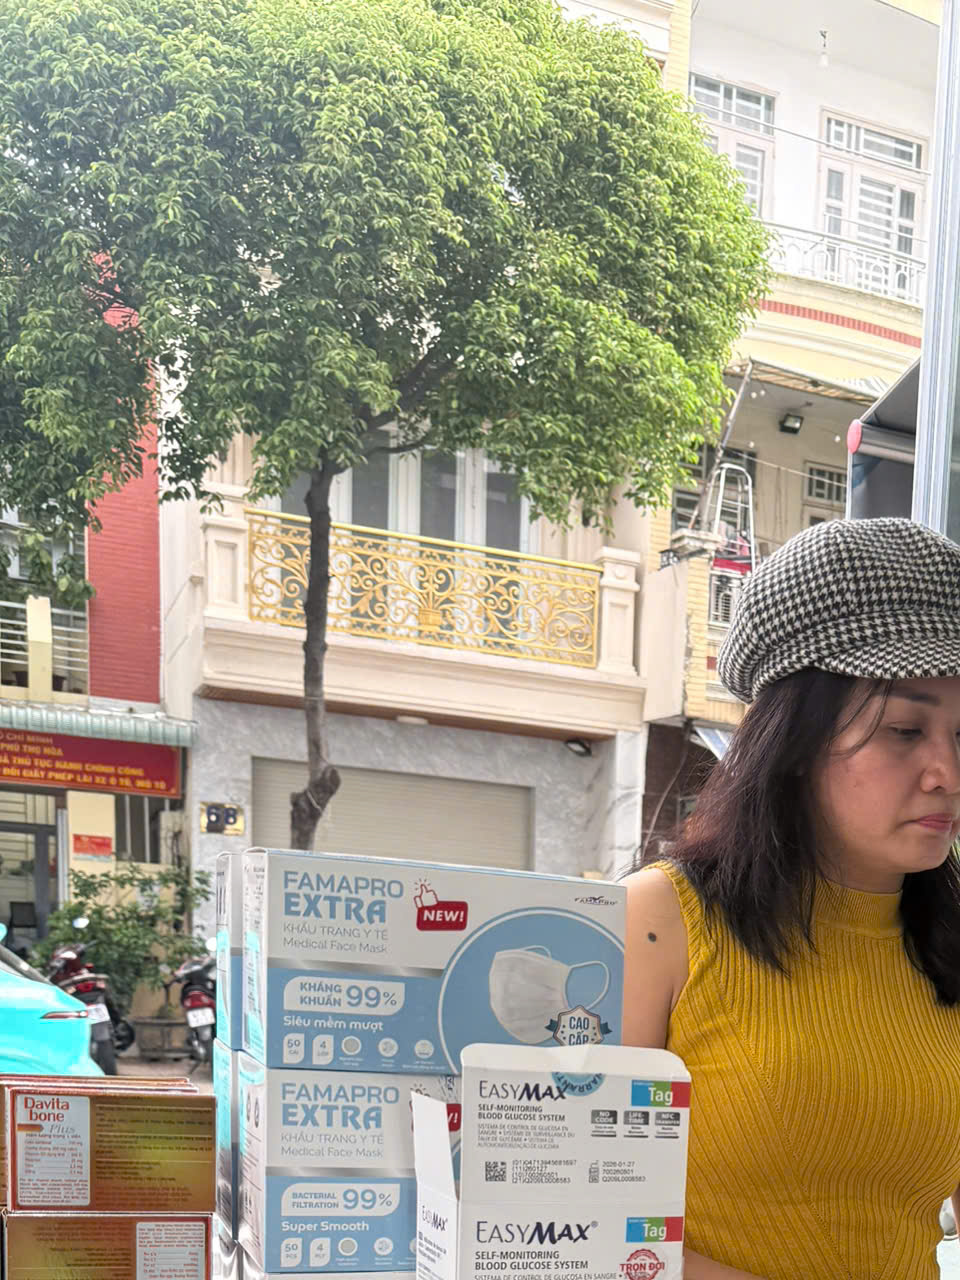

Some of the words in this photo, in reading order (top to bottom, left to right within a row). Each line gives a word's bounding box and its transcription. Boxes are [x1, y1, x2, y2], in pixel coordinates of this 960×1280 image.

[283, 870, 404, 898] FAMAPRO
[284, 892, 386, 924] EXTRA
[423, 910, 465, 922] NEW!
[320, 926, 360, 938] TRANG
[364, 929, 372, 938] Y
[283, 937, 327, 950] Medical
[330, 940, 356, 951] Face
[360, 943, 387, 954] Mask
[300, 981, 341, 993] KHÁNG
[284, 1016, 311, 1026] Siêu
[569, 1017, 589, 1030] CAO
[288, 1038, 300, 1048] 50
[281, 1083, 400, 1104] FAMAPRO
[479, 1080, 567, 1101] EASYMAX
[648, 1087, 673, 1105] Tag
[24, 1097, 70, 1110] Davita
[478, 1104, 542, 1113] SELF-MONITORING
[29, 1109, 64, 1121] bone
[283, 1104, 382, 1130] EXTRA
[478, 1112, 502, 1120] BLOOD
[505, 1113, 536, 1121] GLUCOSE
[539, 1113, 565, 1122] SYSTEM
[49, 1124, 76, 1134] Plus
[319, 1134, 356, 1144] TRANG
[281, 1147, 324, 1157] Medical
[328, 1148, 352, 1157] Face
[356, 1148, 383, 1158] Mask
[292, 1192, 337, 1200] BACTERIAL
[292, 1201, 339, 1209] FILTRATION
[281, 1222, 317, 1233] Super
[321, 1221, 369, 1231] Smooth
[476, 1220, 591, 1245] EASYMAX
[643, 1224, 667, 1240] Tag
[285, 1243, 298, 1252] 50
[475, 1251, 559, 1260] SELF-MONITORING
[475, 1261, 509, 1270] BLOOD
[512, 1261, 552, 1270] GLUCOSE
[555, 1260, 588, 1269] SYSTEM
